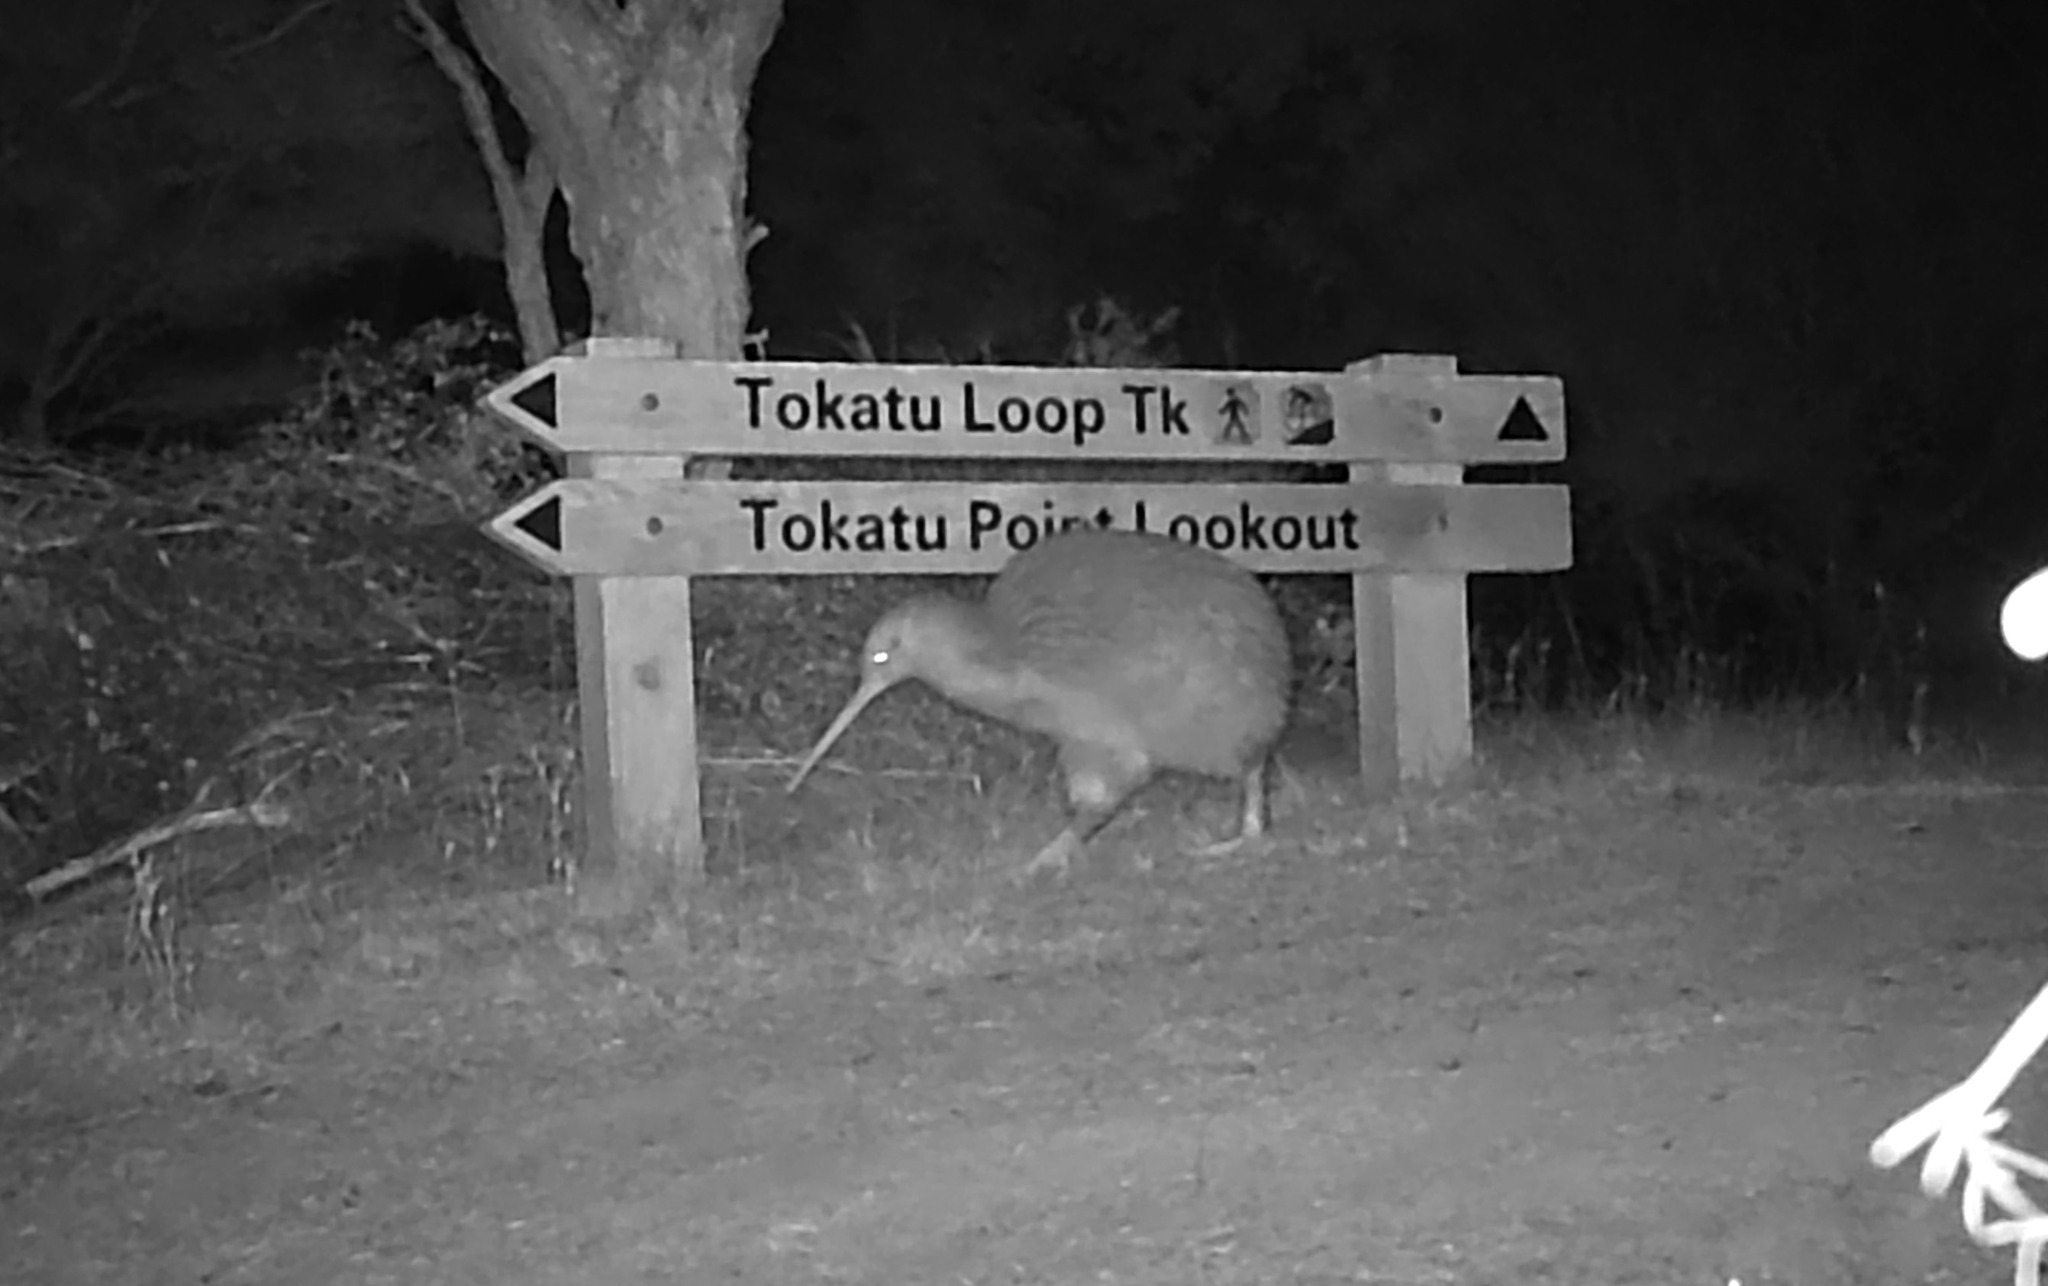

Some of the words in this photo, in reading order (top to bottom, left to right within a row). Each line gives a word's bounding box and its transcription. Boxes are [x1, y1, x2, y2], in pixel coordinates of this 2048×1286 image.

[735, 378, 941, 431] Tokatu
[964, 382, 1105, 446] Loop
[1122, 385, 1190, 434] Tk
[740, 499, 946, 551] Tokatu
